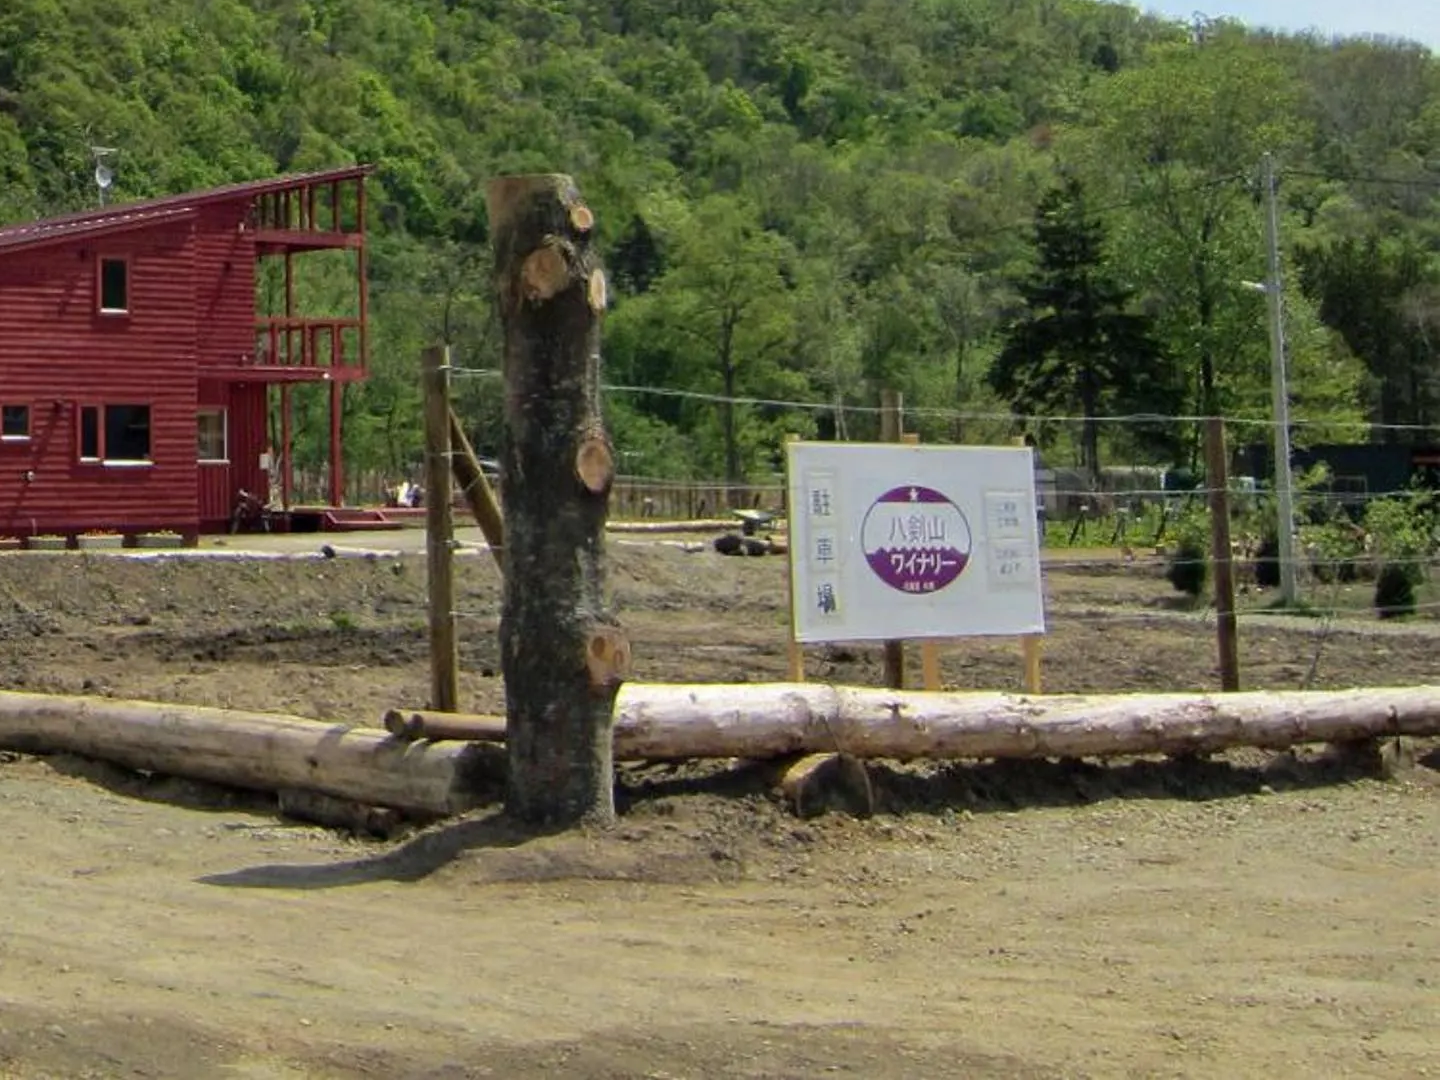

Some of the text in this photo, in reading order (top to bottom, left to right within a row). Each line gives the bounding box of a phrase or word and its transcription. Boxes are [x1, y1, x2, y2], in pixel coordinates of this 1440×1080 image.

[890, 553, 957, 576] ワイナリー
